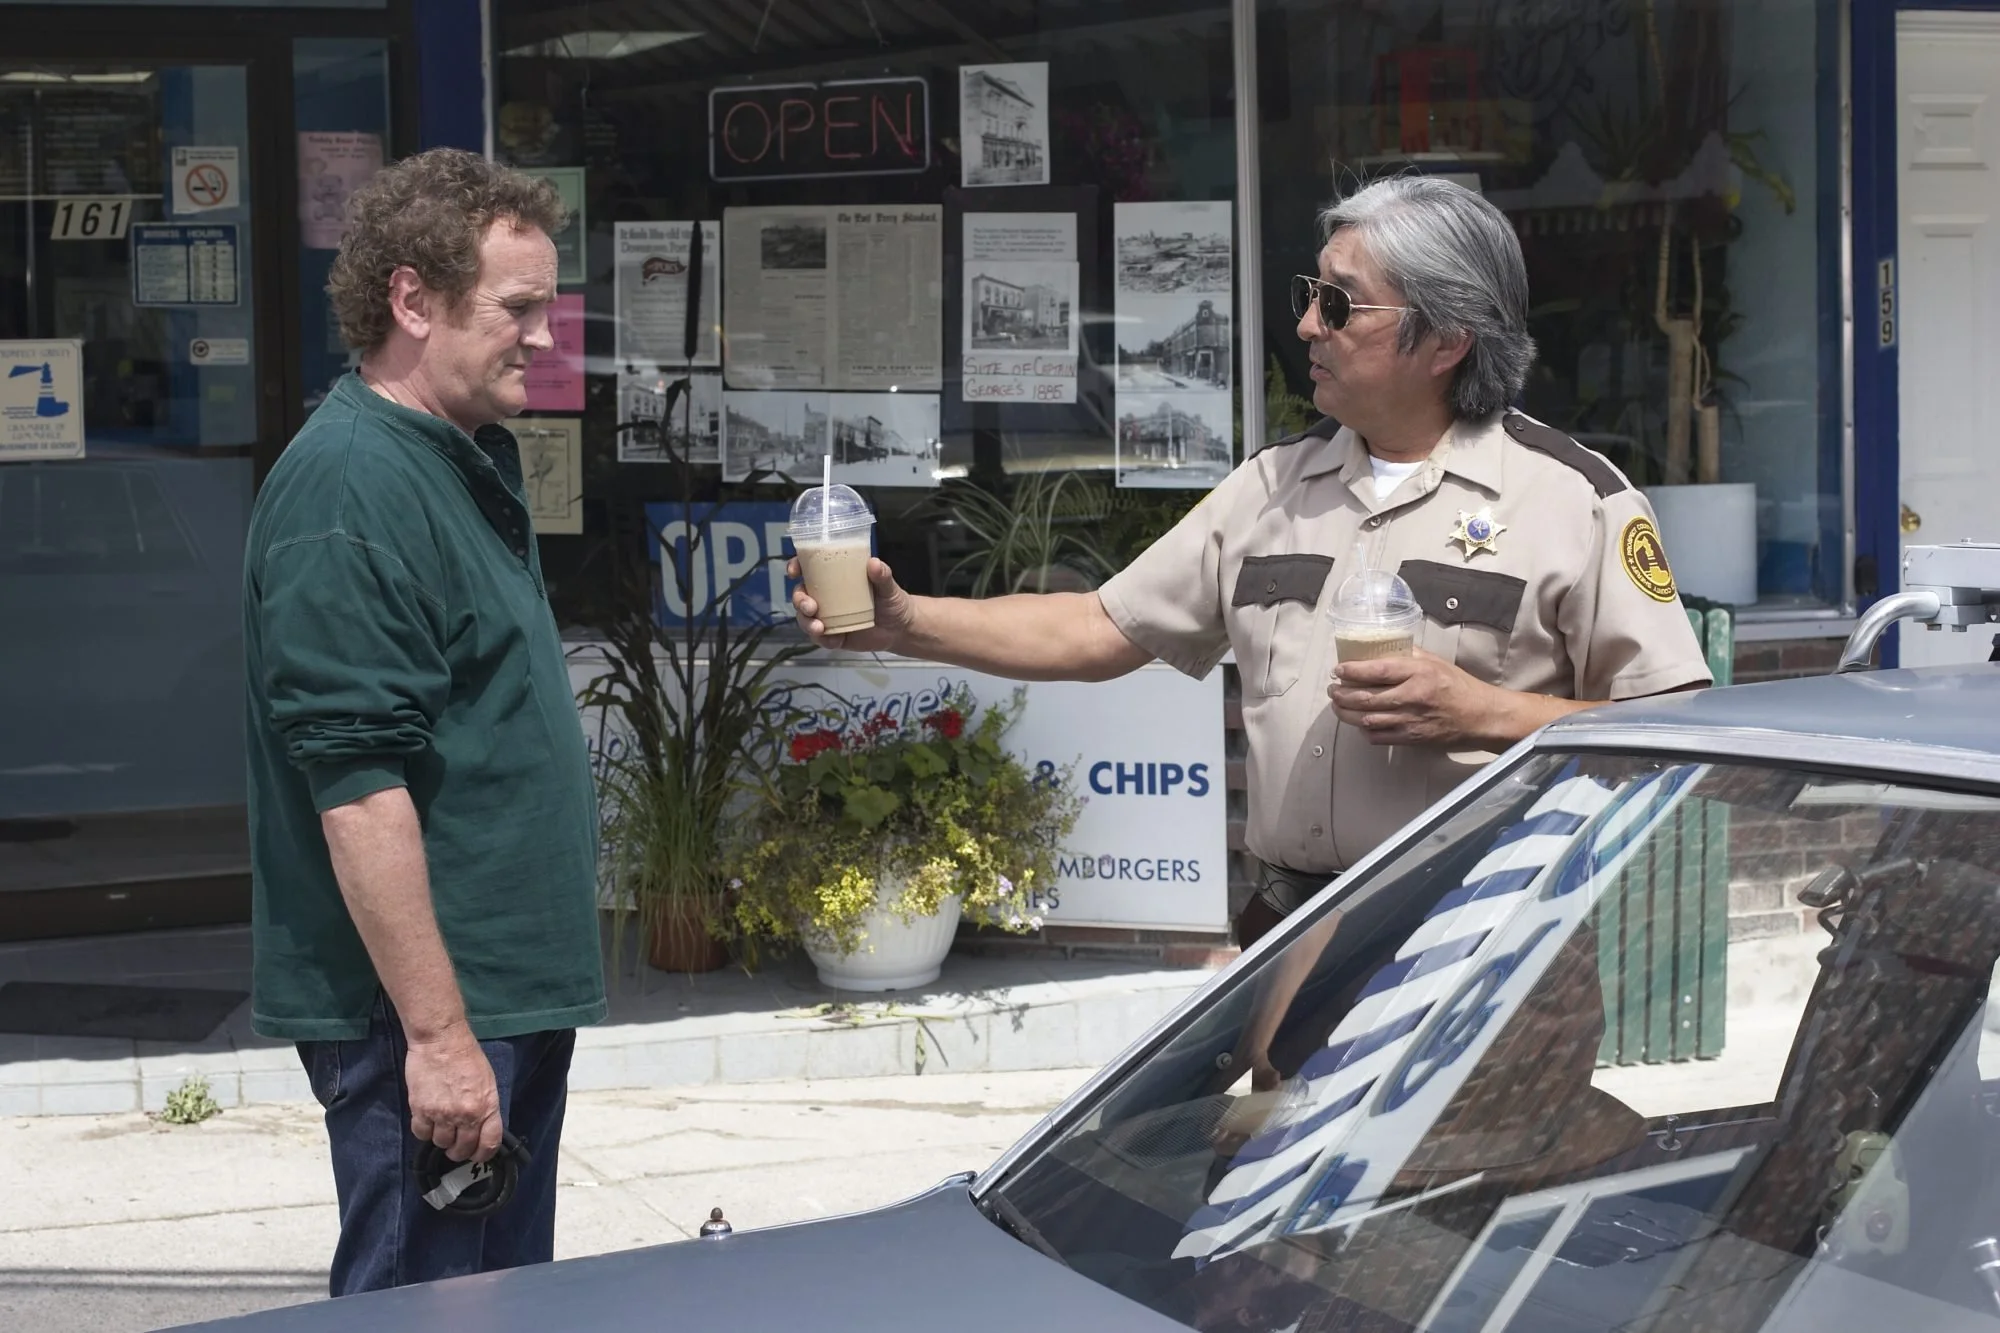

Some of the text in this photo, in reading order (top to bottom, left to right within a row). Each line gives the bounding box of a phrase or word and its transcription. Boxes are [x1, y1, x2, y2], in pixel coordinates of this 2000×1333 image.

[723, 92, 917, 162] OPEN
[62, 202, 122, 236] 161
[1881, 262, 1893, 344] 159
[660, 520, 798, 619] OPE
[1088, 760, 1210, 798] CHIPS
[1050, 856, 1201, 883] MBURGERS
